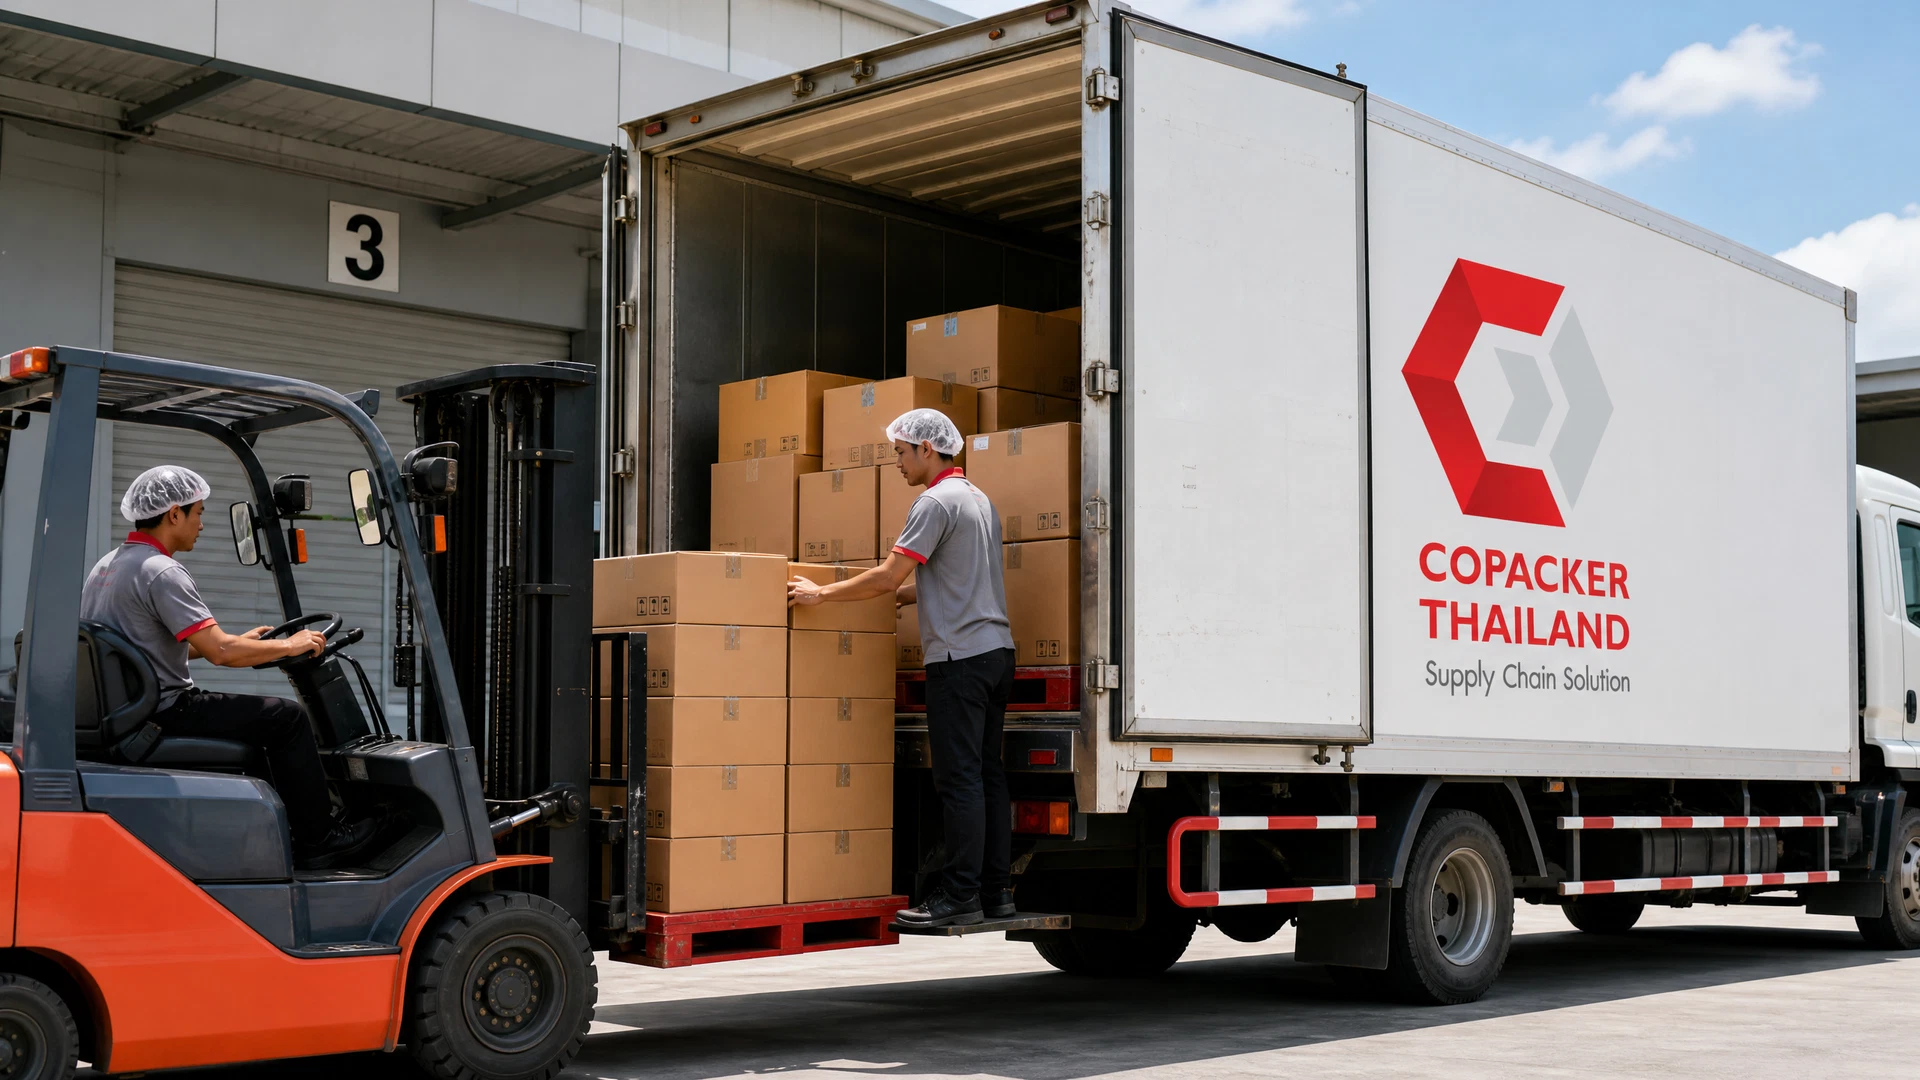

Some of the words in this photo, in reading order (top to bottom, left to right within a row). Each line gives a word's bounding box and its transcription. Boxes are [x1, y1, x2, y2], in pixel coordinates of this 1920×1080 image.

[345, 213, 385, 281] 3
[1419, 541, 1630, 600] COPACKER
[1419, 598, 1630, 651] THAILAND
[1425, 659, 1496, 697] Supply
[1502, 661, 1557, 690] Chain
[1563, 664, 1631, 693] Solution
